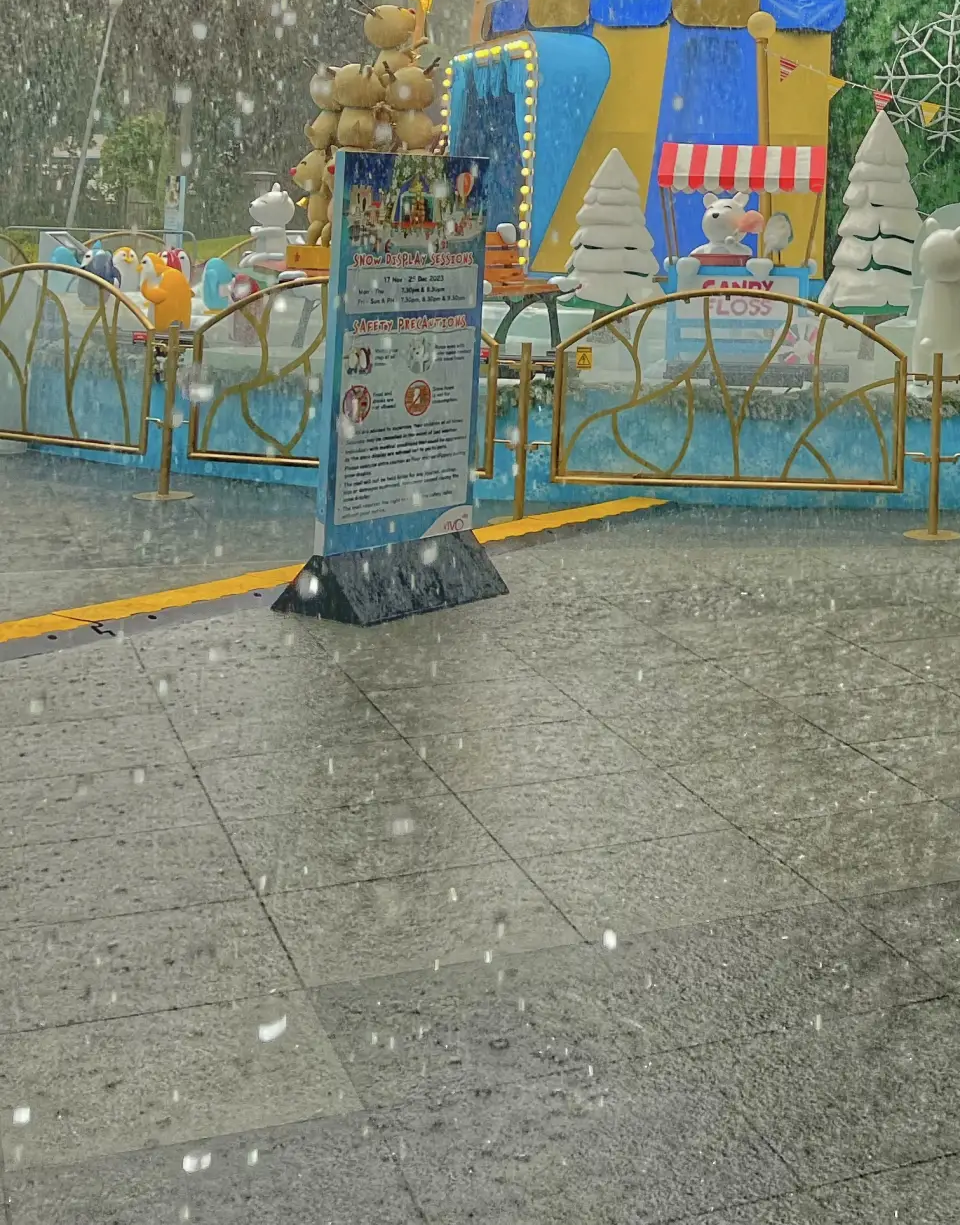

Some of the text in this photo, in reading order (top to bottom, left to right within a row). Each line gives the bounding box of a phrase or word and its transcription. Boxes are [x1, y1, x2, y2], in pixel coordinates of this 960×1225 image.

[353, 252, 474, 267] SNOW DISPLAY SESSIONS
[353, 315, 467, 334] SAFETY PRECAUTIONS
